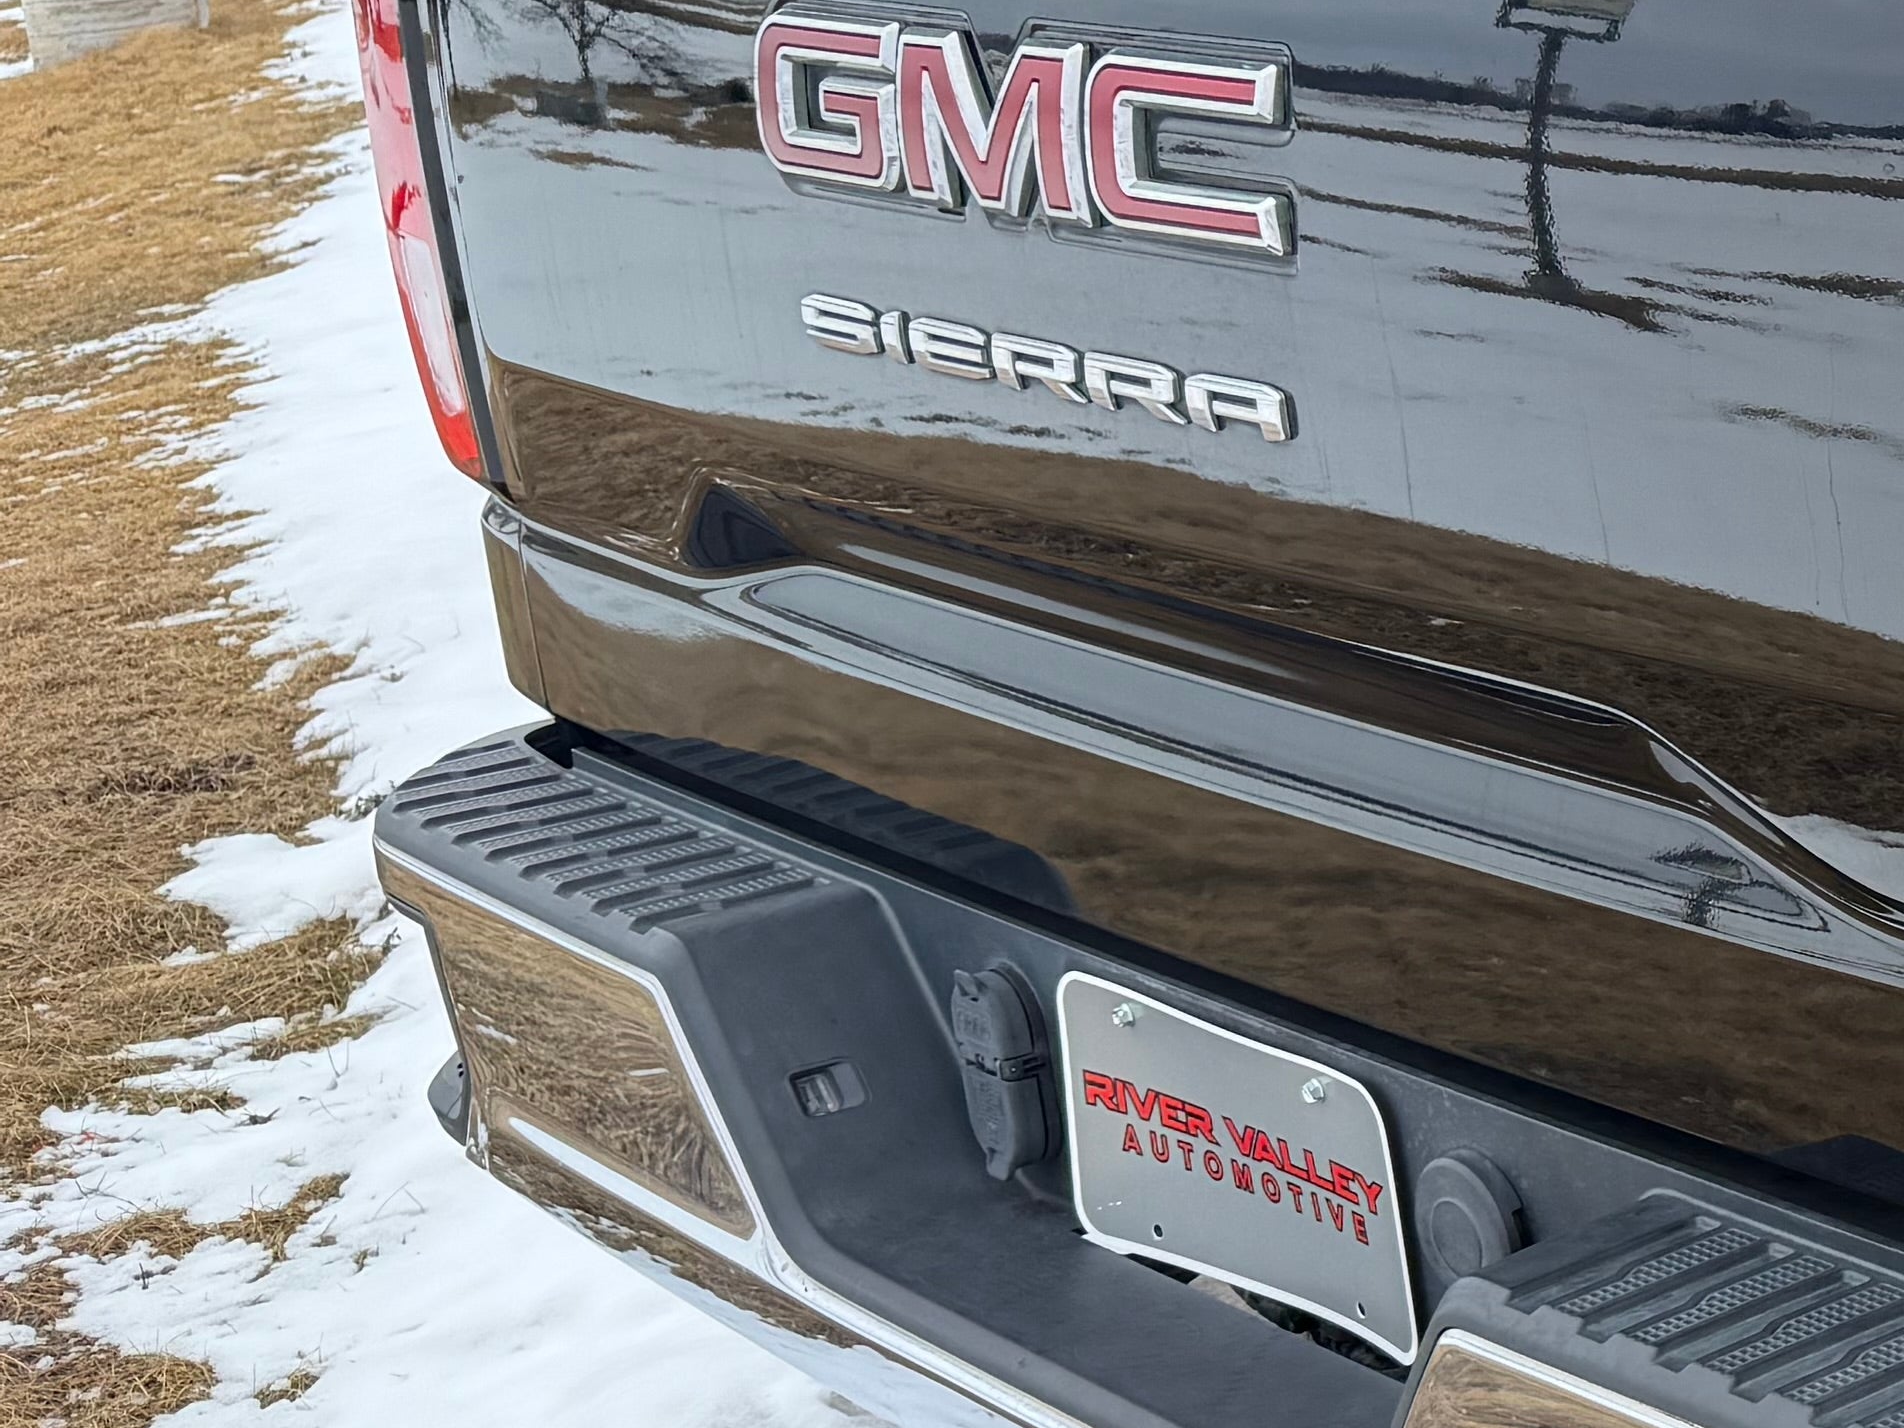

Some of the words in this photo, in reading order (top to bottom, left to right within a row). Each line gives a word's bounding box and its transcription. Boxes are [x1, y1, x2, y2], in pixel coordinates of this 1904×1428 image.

[754, 4, 1294, 257] GMC
[801, 292, 1299, 443] SIERRA
[1082, 1069, 1222, 1147] RIVER
[1221, 1115, 1384, 1216] VALLEY
[1122, 1123, 1371, 1246] AUTOMOTIVE
